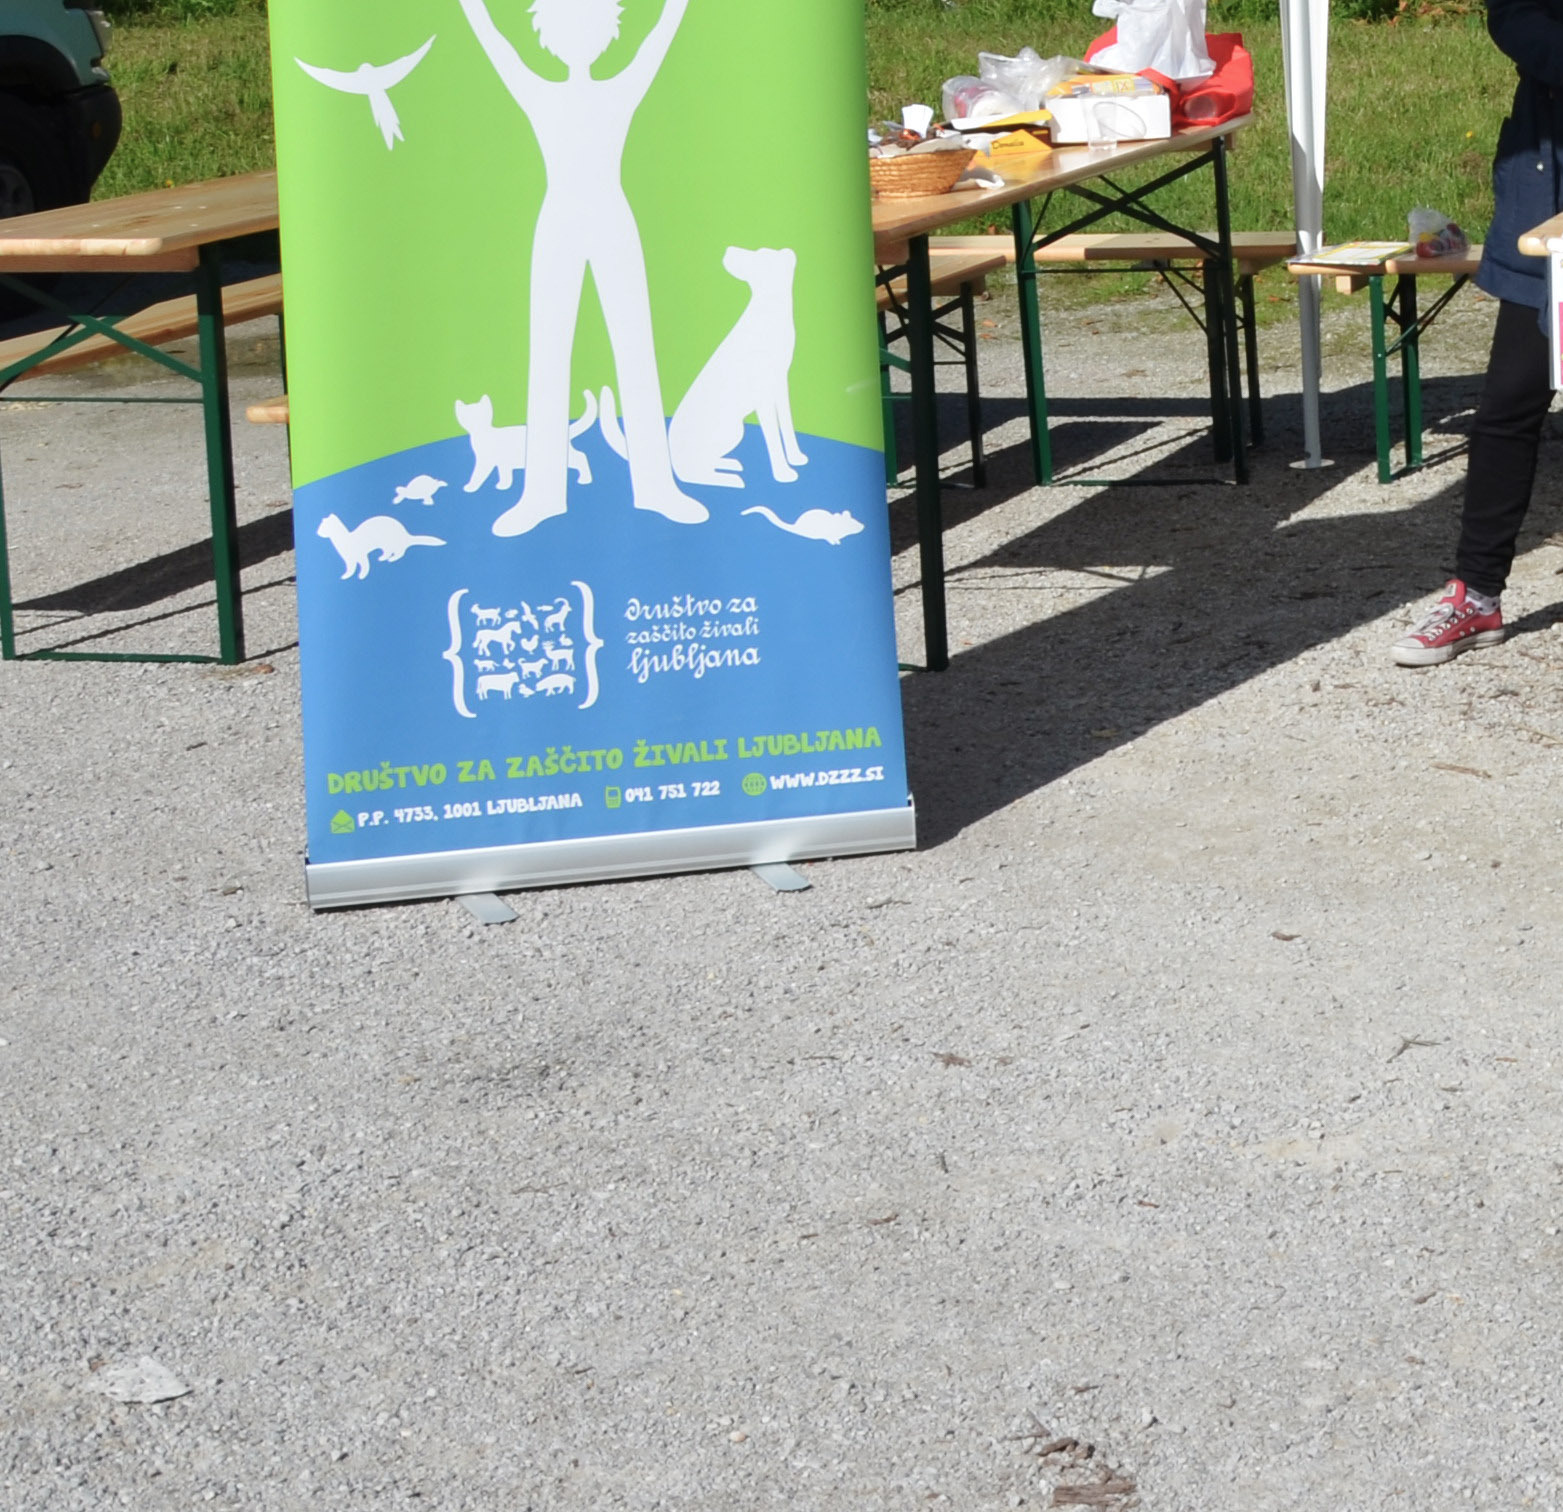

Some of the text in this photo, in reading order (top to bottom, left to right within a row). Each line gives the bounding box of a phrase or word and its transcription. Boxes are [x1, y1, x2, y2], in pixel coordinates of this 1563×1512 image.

[726, 596, 758, 613] za
[626, 616, 760, 644] zaščito živali
[626, 642, 761, 683] ljubljana
[328, 727, 882, 794] DRUŠTVO ZA ZAŠČITO ŽIVALI LJUBLJANA
[624, 780, 720, 802] 041 751 722
[769, 766, 884, 790] WWW.DZZZ.SI
[357, 810, 388, 827] P.P.
[443, 801, 482, 819] 1001
[486, 792, 583, 815] LJUBLJANA
